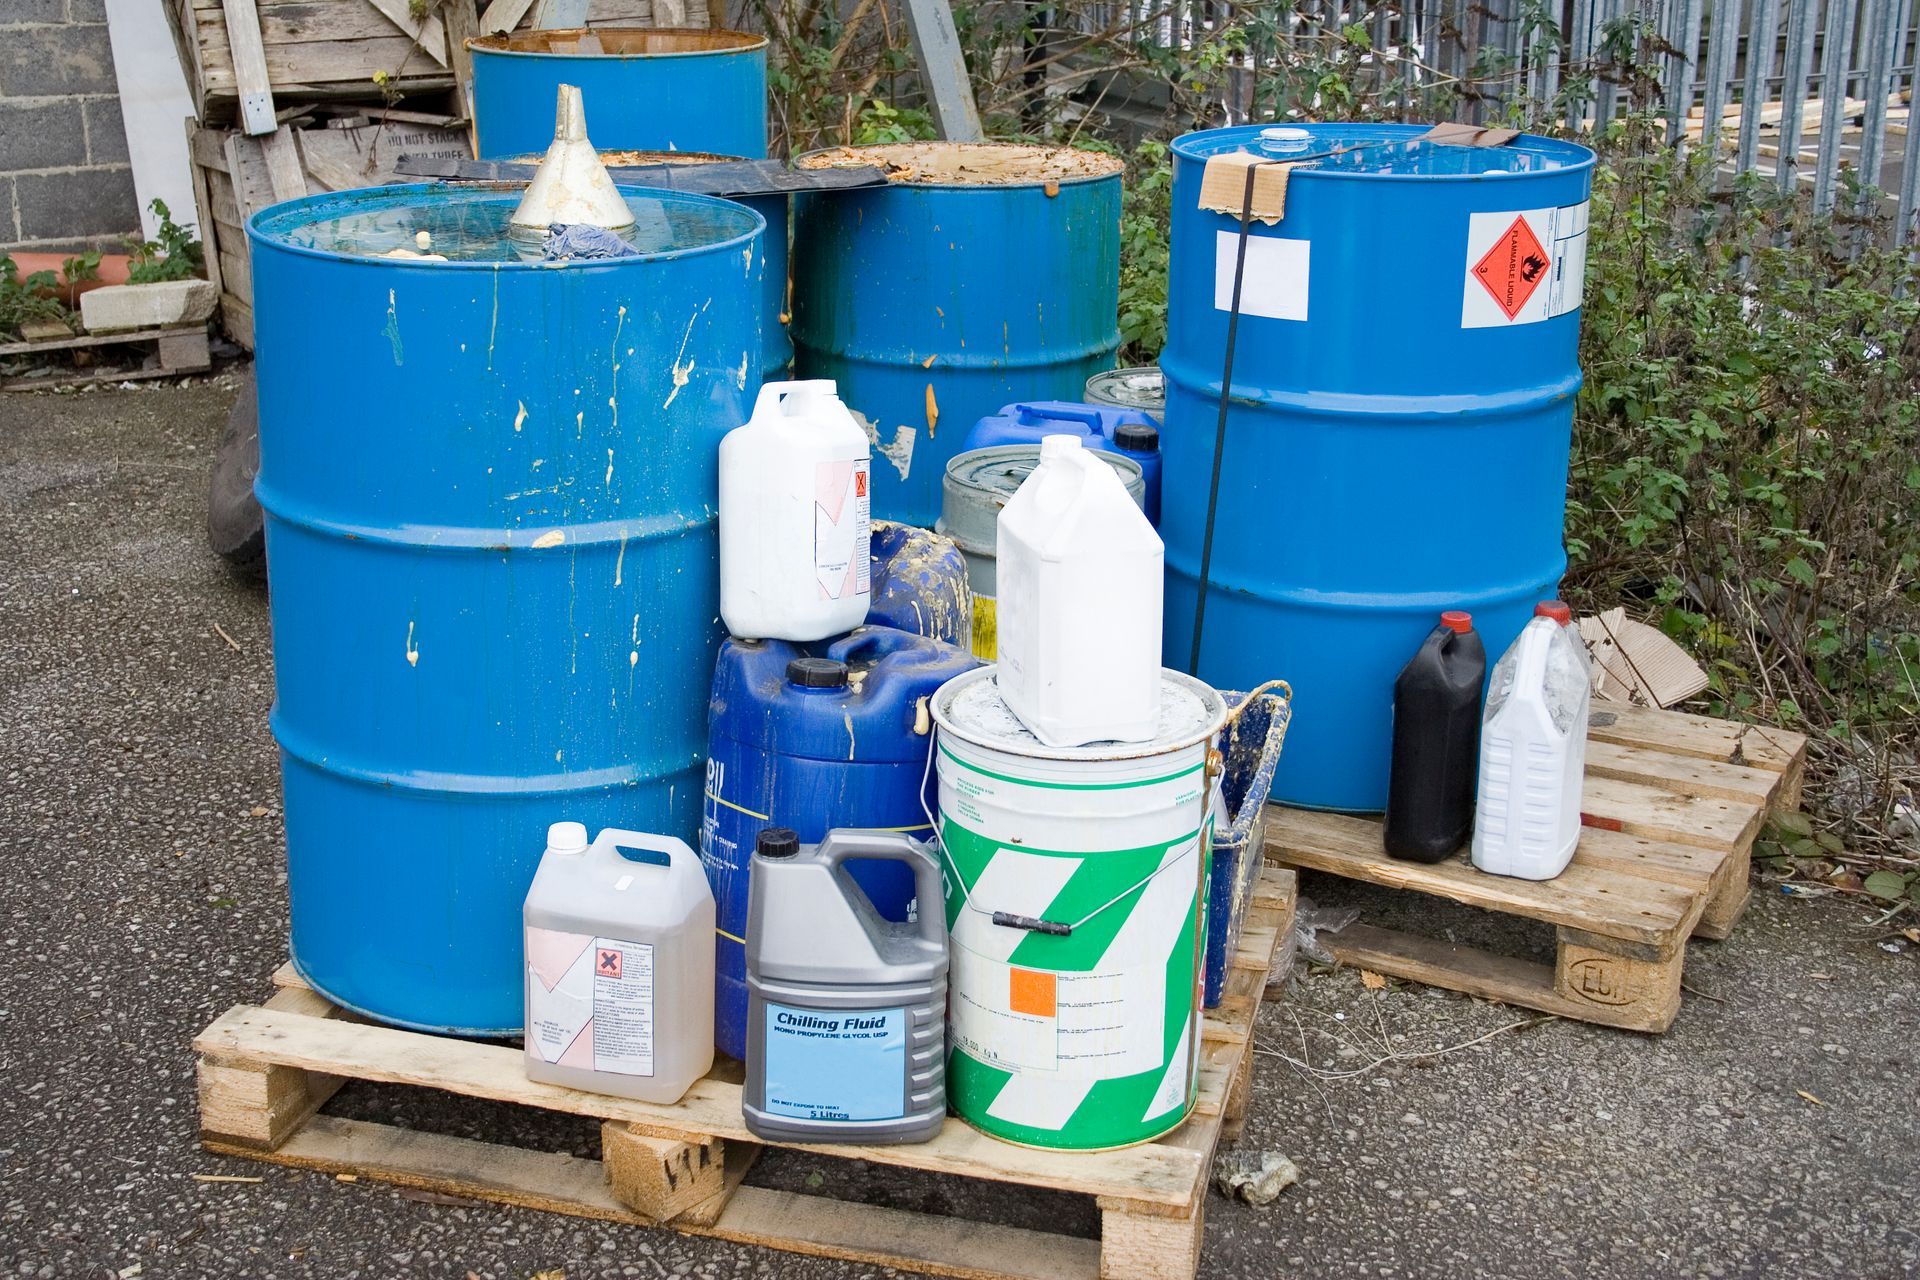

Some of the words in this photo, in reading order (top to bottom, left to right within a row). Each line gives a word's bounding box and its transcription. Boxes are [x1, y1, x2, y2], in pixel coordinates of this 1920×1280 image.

[405, 133, 424, 145] NOT
[427, 131, 461, 144] STACK
[1508, 230, 1518, 280] FLAMMABLE
[1506, 281, 1514, 307] LIQUID
[777, 1012, 840, 1032] Chilling
[843, 1016, 887, 1030] Fluid
[774, 1025, 796, 1035] MONO
[797, 1030, 841, 1039] PROPYLENE
[810, 1110, 817, 1118] 5
[820, 1110, 850, 1119] Litres
